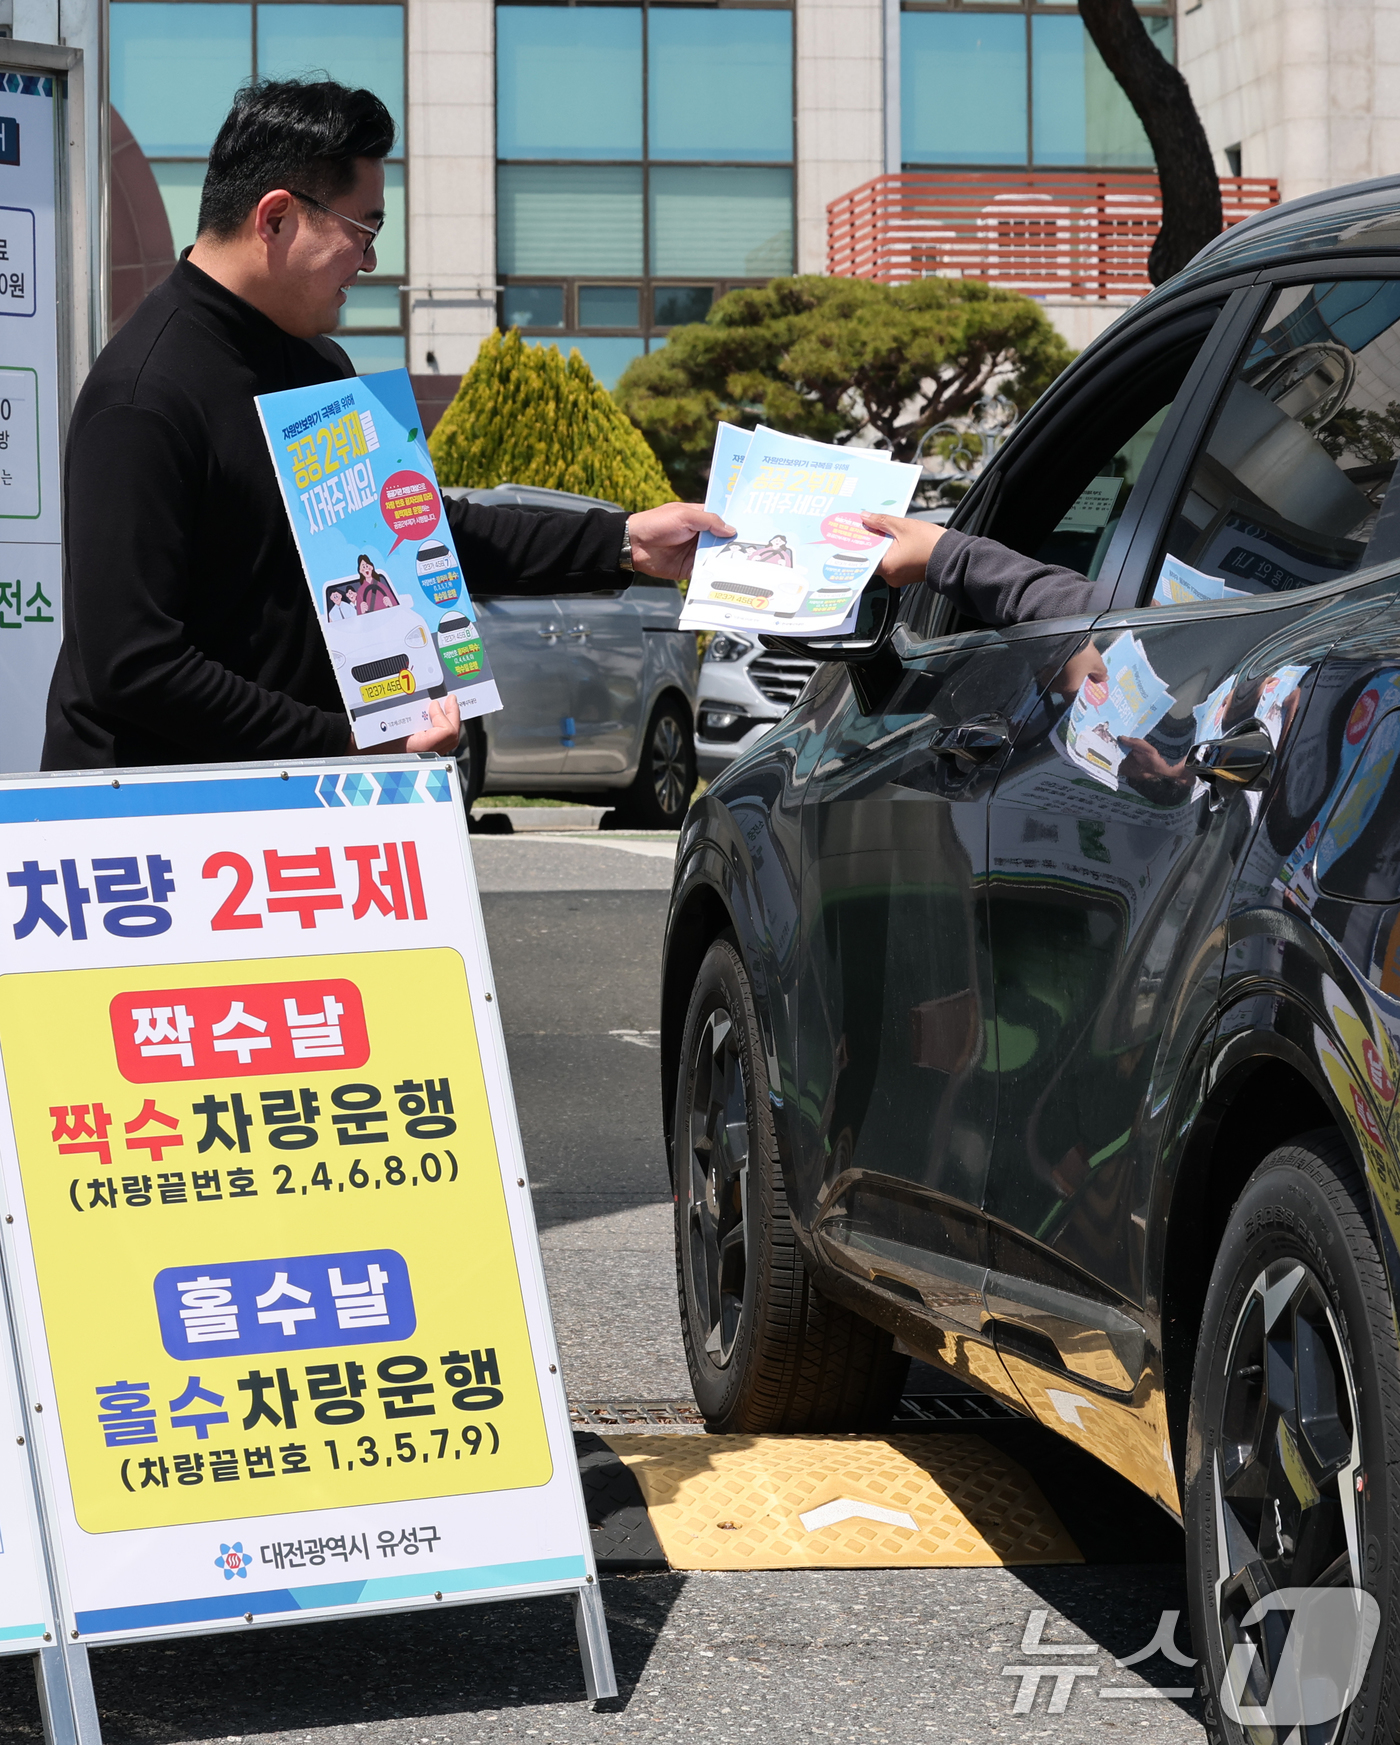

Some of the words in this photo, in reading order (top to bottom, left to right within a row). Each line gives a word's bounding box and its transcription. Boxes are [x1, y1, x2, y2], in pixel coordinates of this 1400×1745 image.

[282, 411, 322, 440] 자원안보위기
[321, 400, 342, 419] 극복을
[340, 393, 356, 410] 위해
[762, 456, 810, 468] 자원안보위기
[810, 460, 833, 470] 극복을
[832, 463, 849, 472] 위해
[300, 458, 378, 535] 지켜주세요!
[743, 492, 835, 516] 지켜주세요!
[366, 686, 386, 698] 123가
[6, 854, 176, 940] 차량
[201, 841, 429, 931] 2부제
[131, 995, 346, 1067] 짝수날
[69, 1166, 259, 1211] (차량끝번호
[176, 1263, 390, 1344] 홀수날
[120, 1442, 310, 1493] (차량끝번호
[260, 1532, 370, 1570] 대전광역시
[376, 1526, 442, 1558] 유성구
